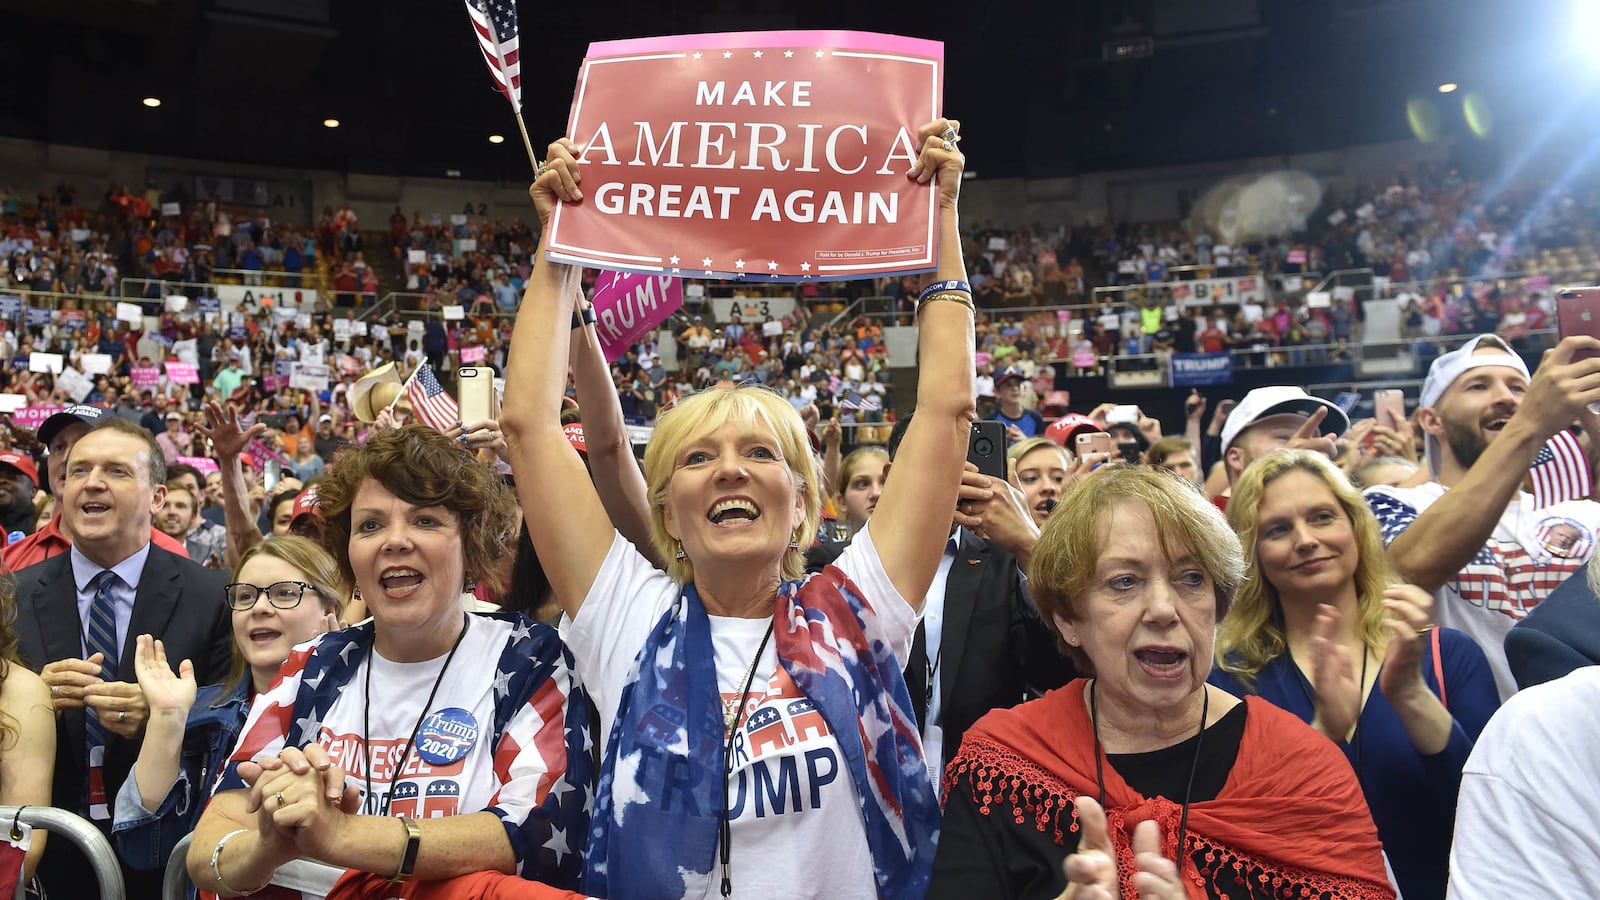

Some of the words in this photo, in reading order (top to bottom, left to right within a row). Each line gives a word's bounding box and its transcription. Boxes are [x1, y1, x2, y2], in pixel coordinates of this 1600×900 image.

[695, 80, 812, 107] MAKE
[576, 121, 920, 175] AMERICA
[594, 182, 740, 219] GREAT
[750, 187, 899, 224] AGAIN
[594, 273, 673, 347] TRUMP
[730, 302, 742, 316] A
[759, 301, 770, 316] 3
[1173, 357, 1230, 371] TRUMP
[427, 713, 477, 742] Trump
[319, 732, 432, 780] TENNESSEE
[419, 738, 459, 760] 2020
